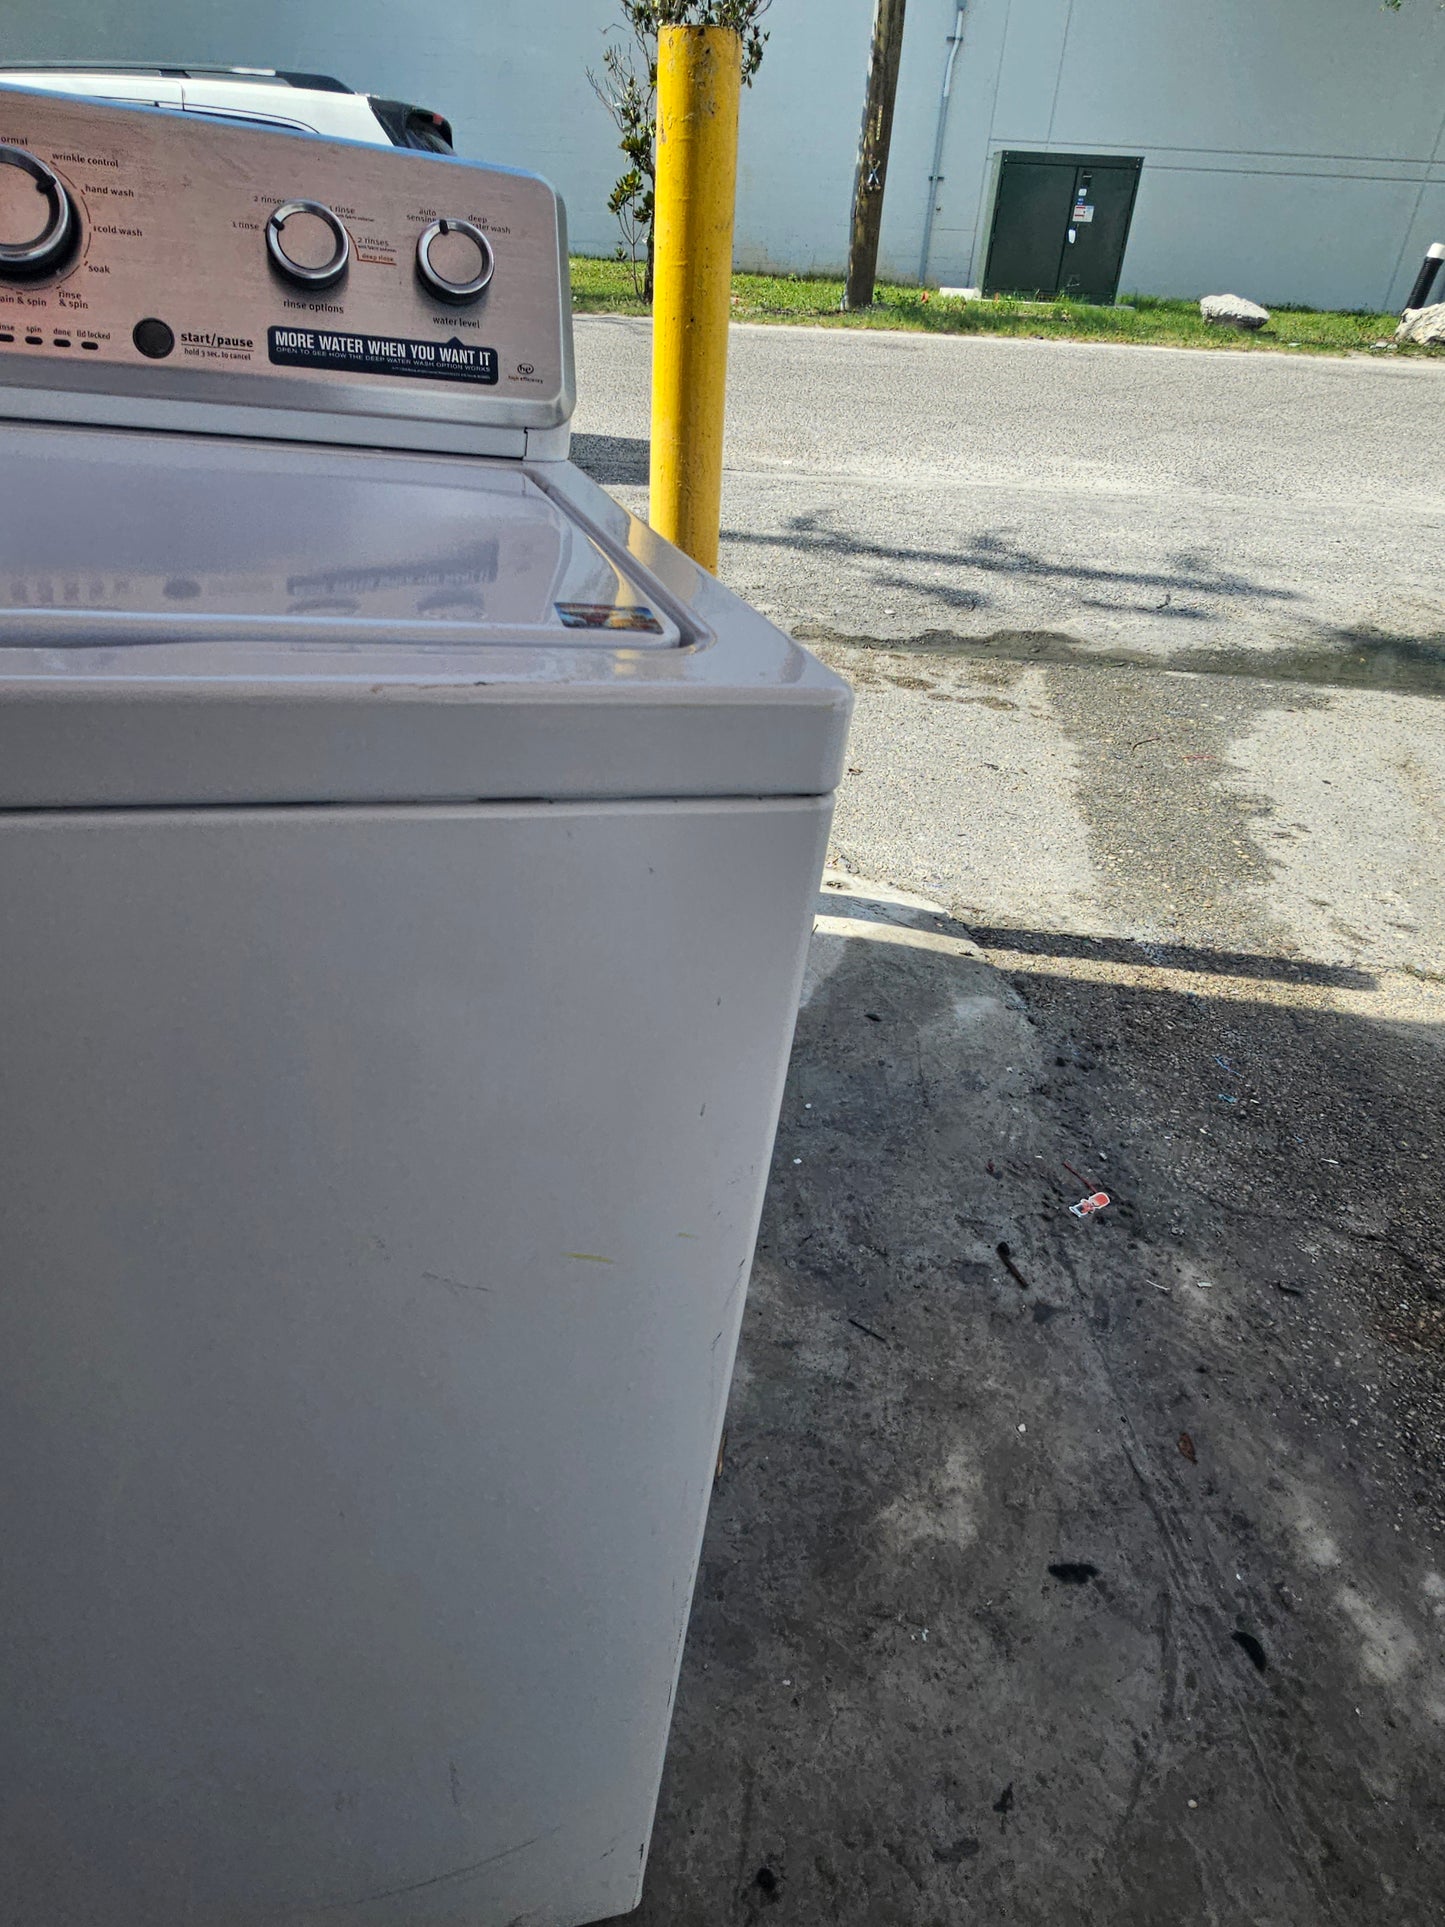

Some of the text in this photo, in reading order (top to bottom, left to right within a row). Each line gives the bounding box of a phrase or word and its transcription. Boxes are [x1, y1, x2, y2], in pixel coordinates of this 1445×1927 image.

[0, 135, 28, 146] ormal
[52, 153, 119, 168] wrinkle control
[85, 184, 134, 198] hand wash
[335, 205, 355, 214] rinse
[468, 215, 488, 223] deep
[238, 221, 260, 230] rinse
[472, 222, 511, 234] ater wash
[98, 226, 143, 237] cold wash
[365, 236, 389, 247] rinses
[88, 265, 111, 274] soak
[58, 291, 82, 300] rinse
[17, 296, 24, 304] &
[27, 297, 47, 307] spin
[59, 299, 89, 310] & spin
[284, 299, 345, 314] rinse options
[433, 317, 480, 329] water level
[26, 324, 42, 334] spin
[53, 327, 71, 337] done
[76, 329, 111, 340] lid locked
[180, 332, 254, 348] start/pause
[184, 347, 200, 356] hold
[221, 351, 229, 359] to
[275, 331, 491, 366] MORE WATER WHEN YOU WANT IT
[276, 346, 298, 354] OPEN
[328, 351, 347, 359] HOW
[387, 357, 411, 365] WATER
[436, 362, 463, 370] OPTION
[465, 365, 491, 373] WORKS
